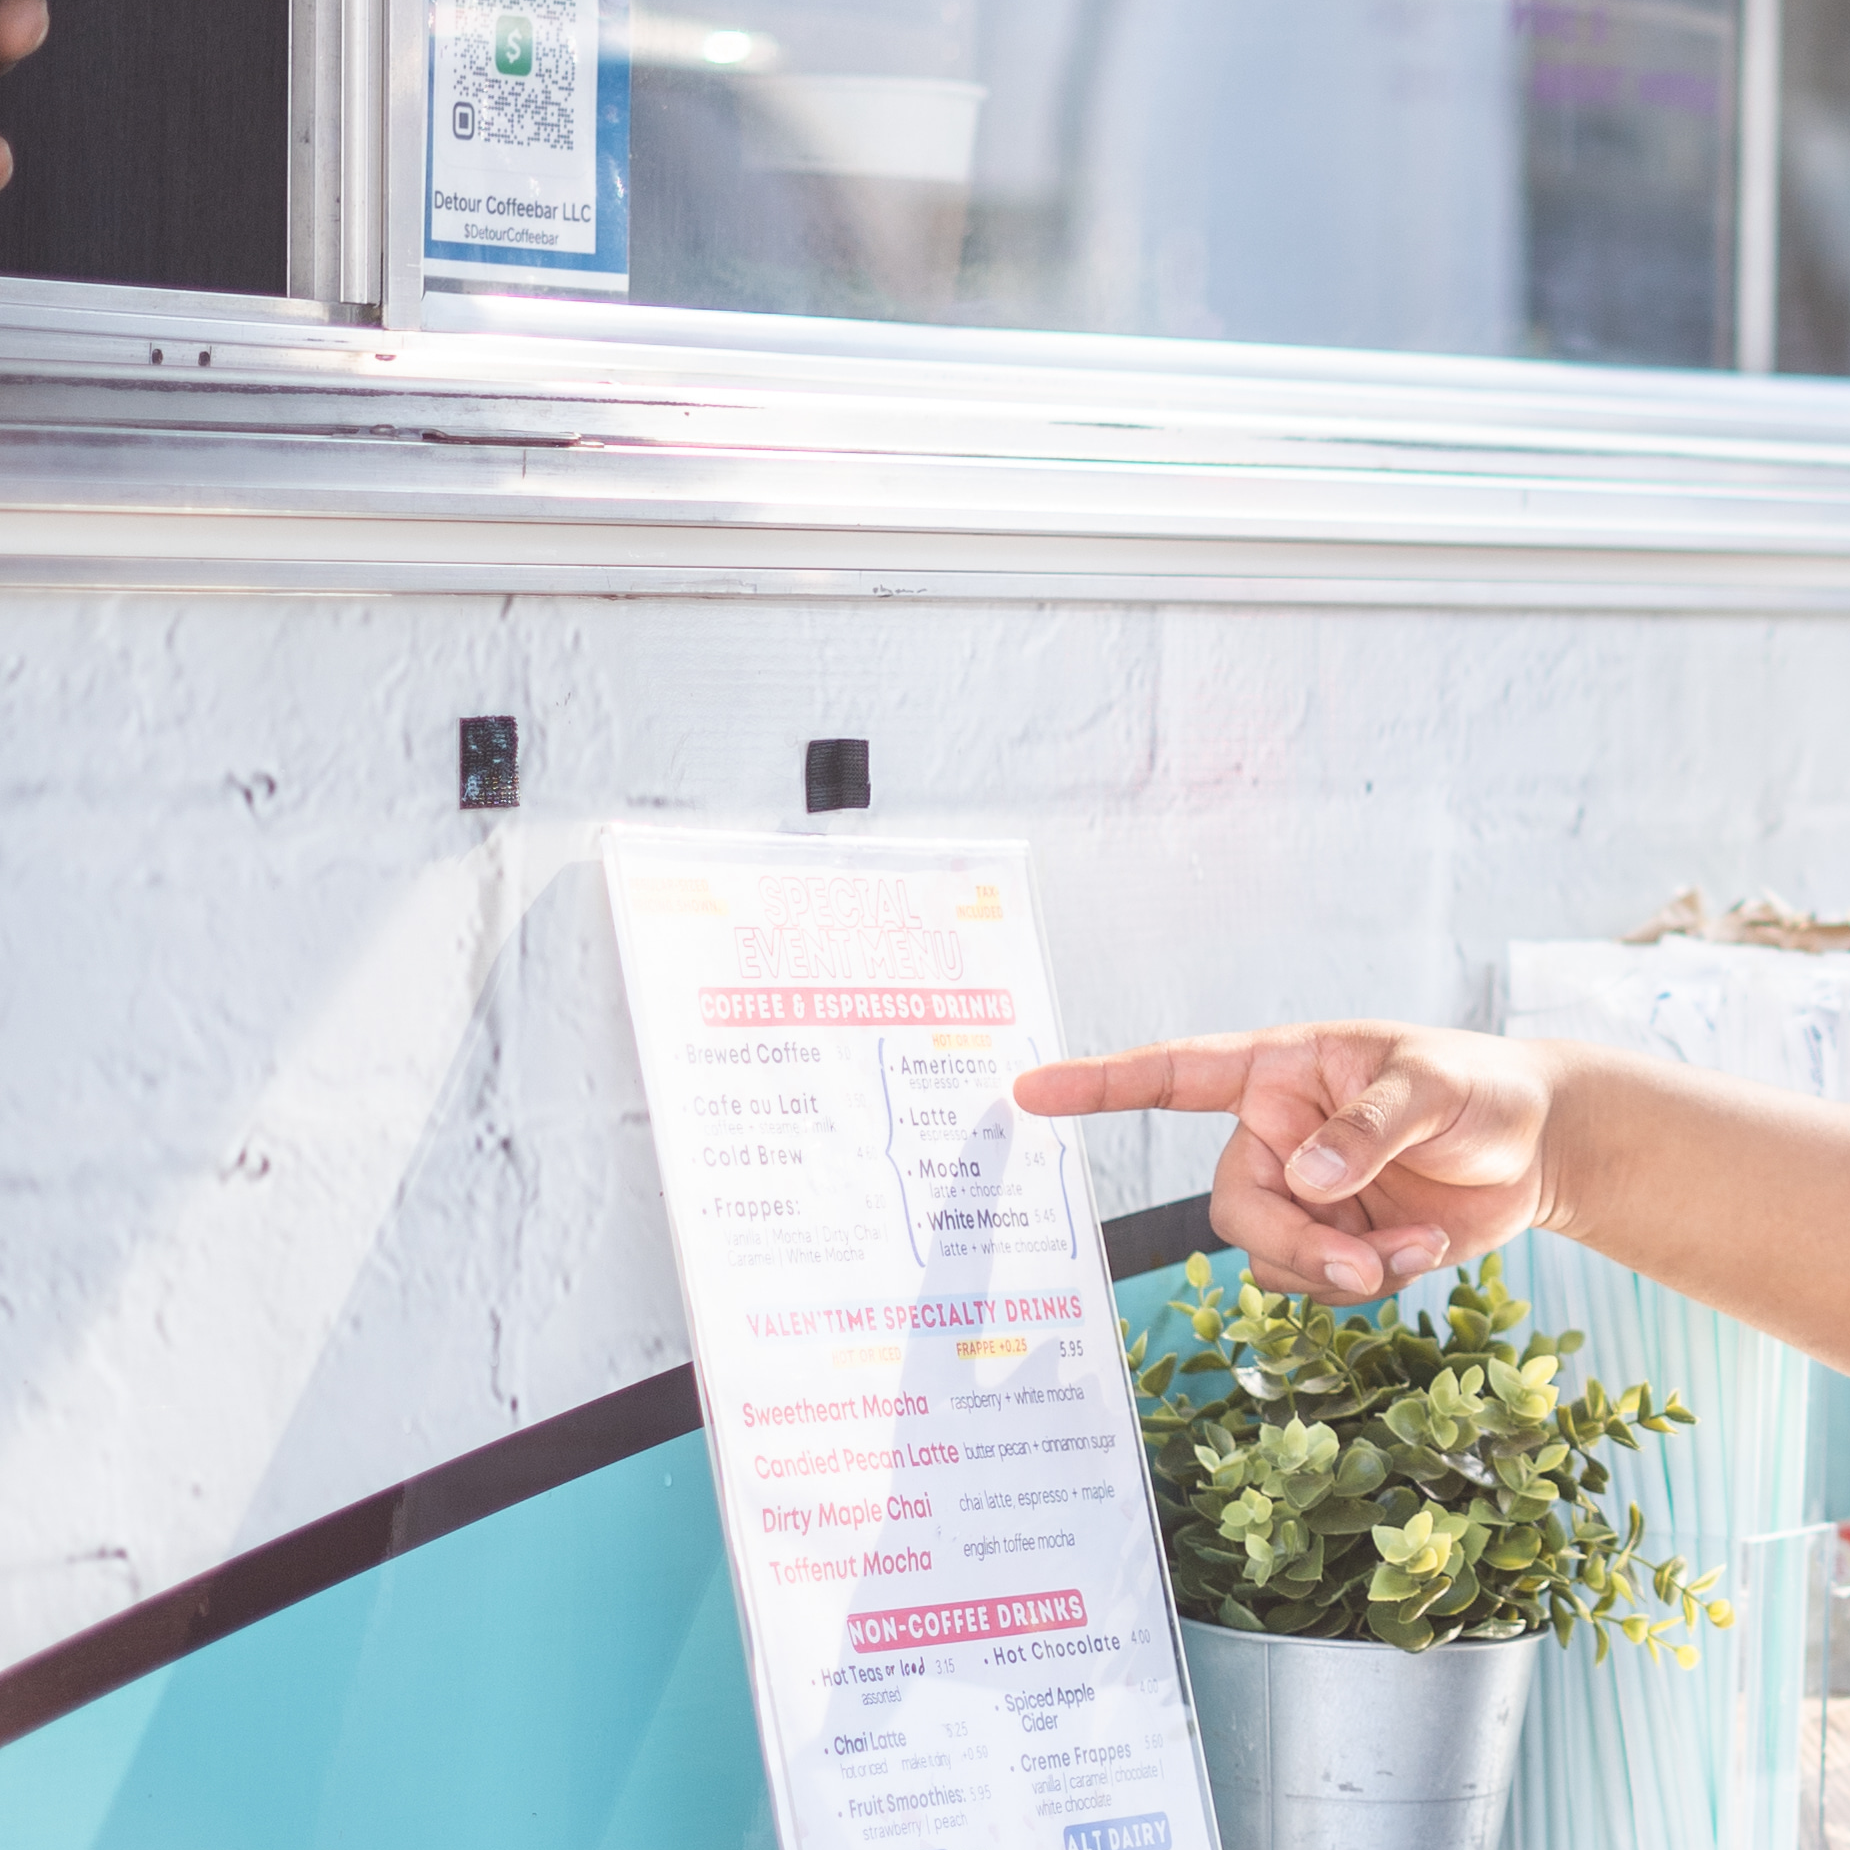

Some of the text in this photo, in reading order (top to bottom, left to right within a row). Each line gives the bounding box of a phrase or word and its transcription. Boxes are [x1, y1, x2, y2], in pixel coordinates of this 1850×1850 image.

[434, 190, 592, 224] Detour Coffeebar LLC
[464, 222, 560, 246] $DetourCoffeebar
[758, 875, 923, 929] SPECIAL
[956, 905, 1004, 920] INCLUDED
[734, 926, 964, 981] EVENT MENU
[701, 993, 1014, 1021] COFFEE & ESPRESSO DRINKS
[932, 1033, 992, 1048] HOT OR ICED
[686, 1043, 751, 1065] Brewed
[757, 1041, 822, 1064] Coffee
[901, 1054, 998, 1076] Americano
[909, 1076, 960, 1093] espresso
[693, 1093, 819, 1117] Cafe au Lait
[909, 1106, 958, 1127] Latte
[703, 1116, 838, 1138] coffee milk
[919, 1122, 1007, 1144] espresso milk
[702, 1144, 803, 1168] Cold Brew
[919, 1156, 982, 1179] Mocha
[929, 1179, 1023, 1199] latte chocolate
[715, 1196, 802, 1222] Frappes:
[926, 1208, 974, 1232] White
[977, 1207, 1030, 1229] Mocha
[723, 1228, 762, 1247] Vanilla
[772, 1227, 812, 1246] Mocha
[854, 1223, 882, 1242] Chai
[939, 1235, 1068, 1257] latte white chocolate
[788, 1248, 822, 1267] White
[825, 1245, 865, 1263] Mocha
[745, 1294, 1083, 1339] VALEN'TIME SPECIALTY DRINKS
[955, 1340, 996, 1357] FRAPPE
[1059, 1340, 1084, 1359] 5.95
[743, 1383, 1085, 1428] Sweetheart Mocha raspberry white mocha
[754, 1432, 1117, 1480] Candied Pecan Latte butter pecan cinnamon sugar
[762, 1505, 812, 1536] Dirty
[817, 1497, 883, 1532] Maple
[886, 1491, 933, 1522] Chai
[959, 1493, 984, 1512] chai
[1017, 1486, 1070, 1510] espresso
[1081, 1480, 1115, 1504] maple
[768, 1527, 1076, 1586] Toffenut Mocha english toffee mocha
[850, 1596, 1084, 1646] NON-COFFEE DRINKS
[993, 1628, 1151, 1667] Hot Chocolate 4.00
[821, 1666, 849, 1688] Hot
[849, 1664, 884, 1684] Teas
[861, 1686, 902, 1707] assorted
[1004, 1685, 1054, 1716] Spiced
[1056, 1682, 1096, 1710] Apple
[1021, 1711, 1059, 1734] Cider
[834, 1730, 869, 1757] Chai
[869, 1729, 908, 1753] Latte
[1020, 1742, 1133, 1774] Creme Frappes
[1031, 1762, 1159, 1796] vanilla caramel chocolate
[849, 1794, 887, 1820] Fruit
[887, 1783, 968, 1813] Smoothies:
[1036, 1792, 1113, 1818] white chocolate
[862, 1809, 969, 1842] strawberry peach
